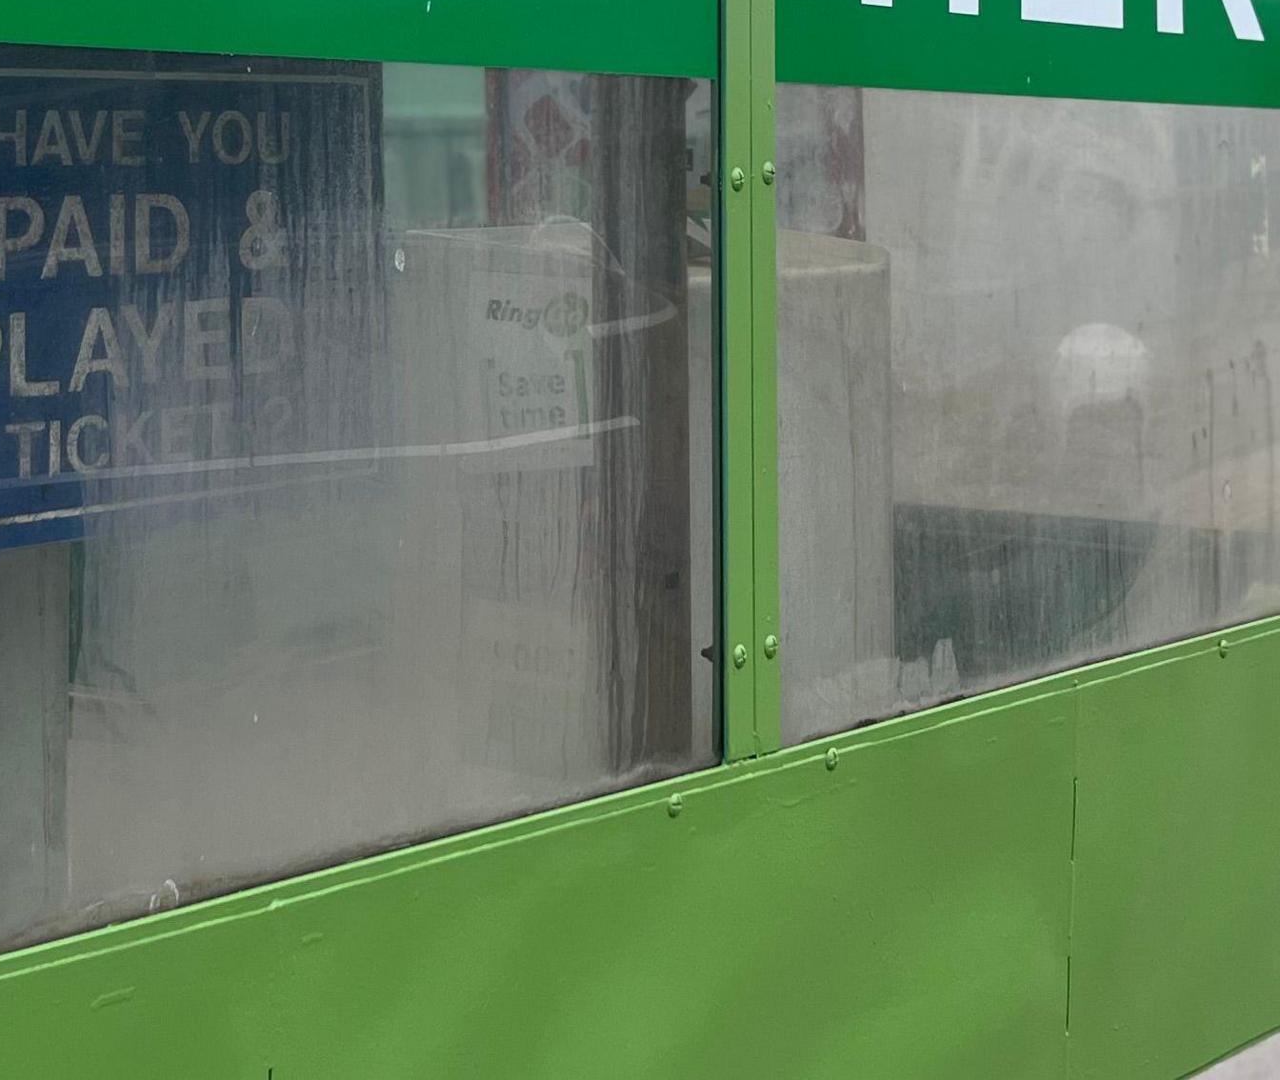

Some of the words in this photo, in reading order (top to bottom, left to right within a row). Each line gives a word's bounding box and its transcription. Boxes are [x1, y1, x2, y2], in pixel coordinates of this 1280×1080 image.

[178, 108, 291, 165] YOU
[238, 190, 292, 272] &
[498, 371, 566, 398] Save
